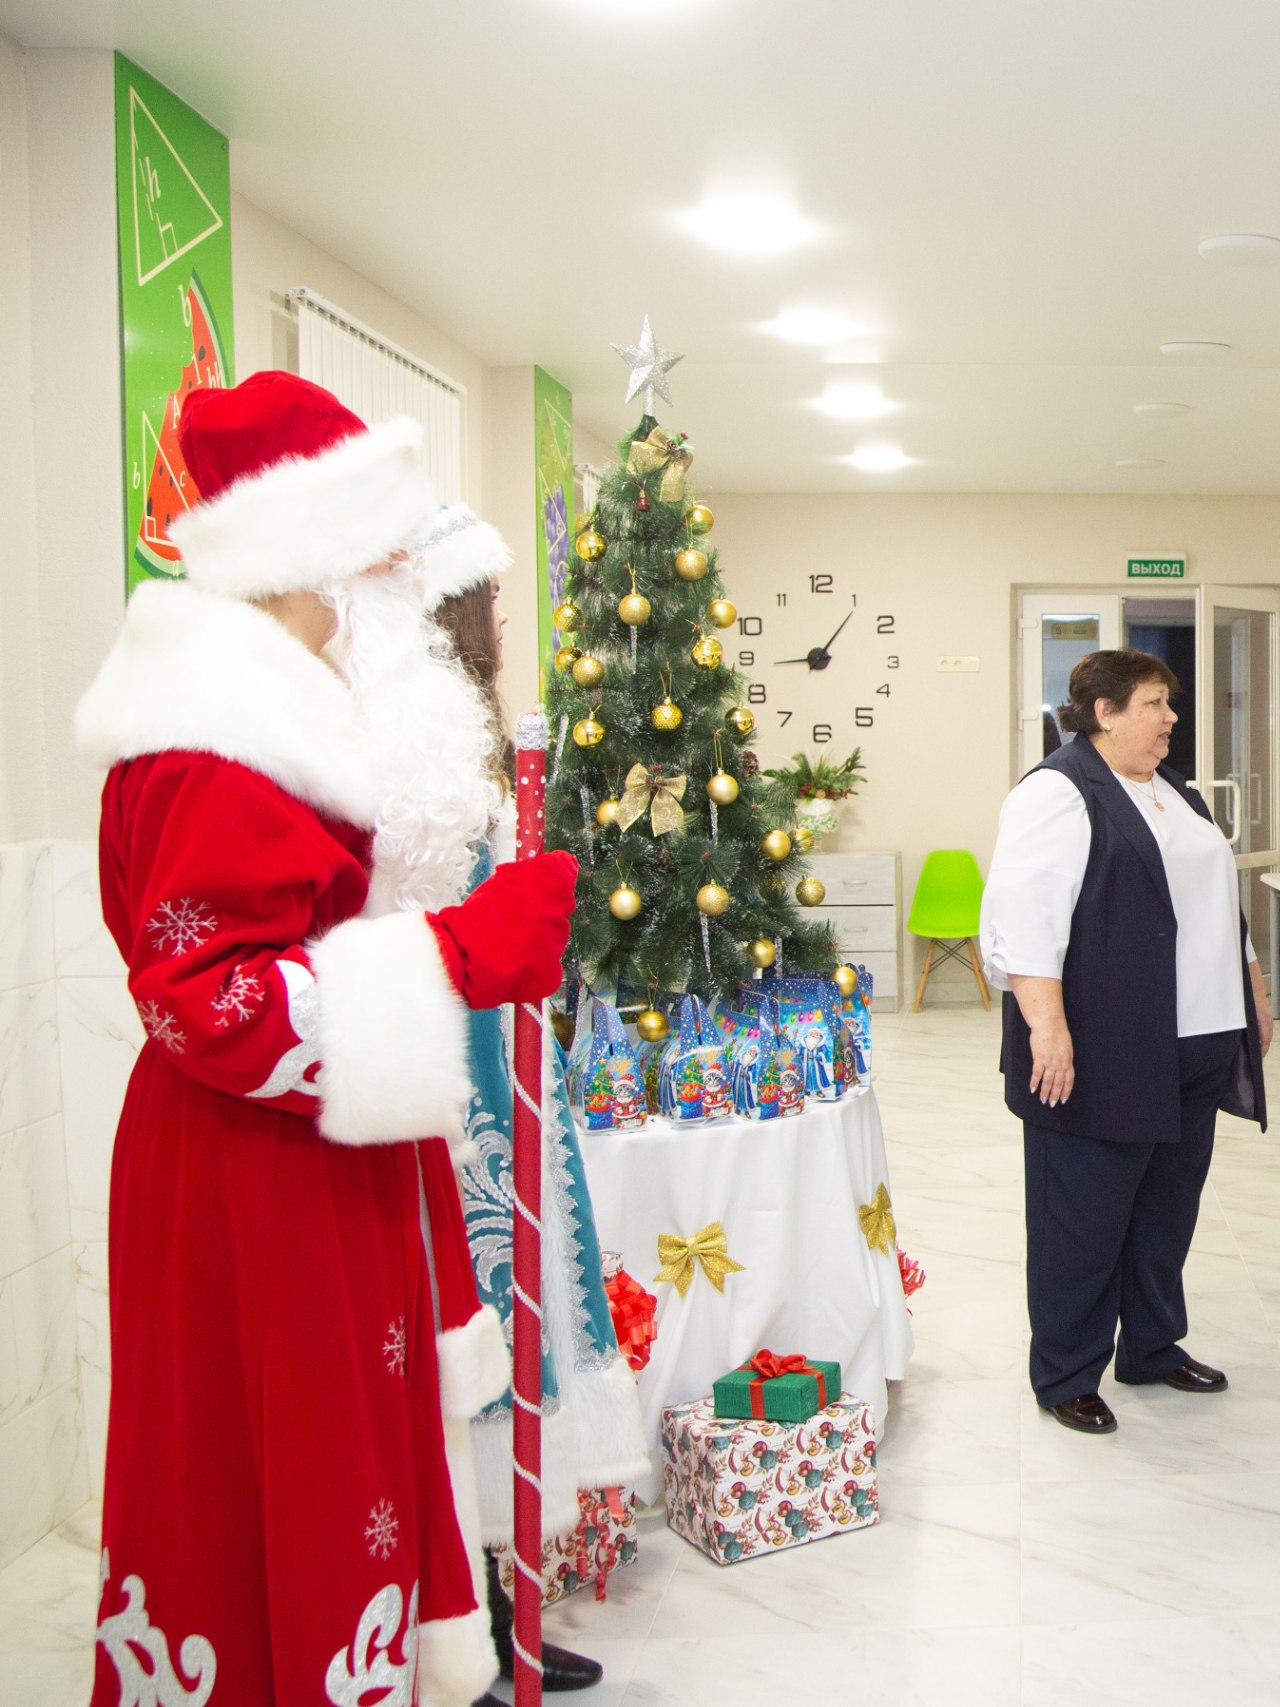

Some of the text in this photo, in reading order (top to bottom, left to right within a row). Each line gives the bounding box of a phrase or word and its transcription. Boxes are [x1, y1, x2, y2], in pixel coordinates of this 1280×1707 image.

[133, 462, 141, 489] b
[1131, 563, 1181, 576] ВЫХОД
[808, 574, 833, 593] 12
[776, 593, 787, 607] 11
[852, 594, 857, 607] 1
[737, 616, 762, 636] 10
[877, 615, 895, 634] 2
[739, 651, 754, 666] 9
[887, 656, 900, 669] 3
[748, 684, 767, 704] 8
[876, 683, 891, 698] 4
[777, 711, 793, 728] 7
[855, 707, 874, 727] 5
[813, 724, 832, 743] 6
